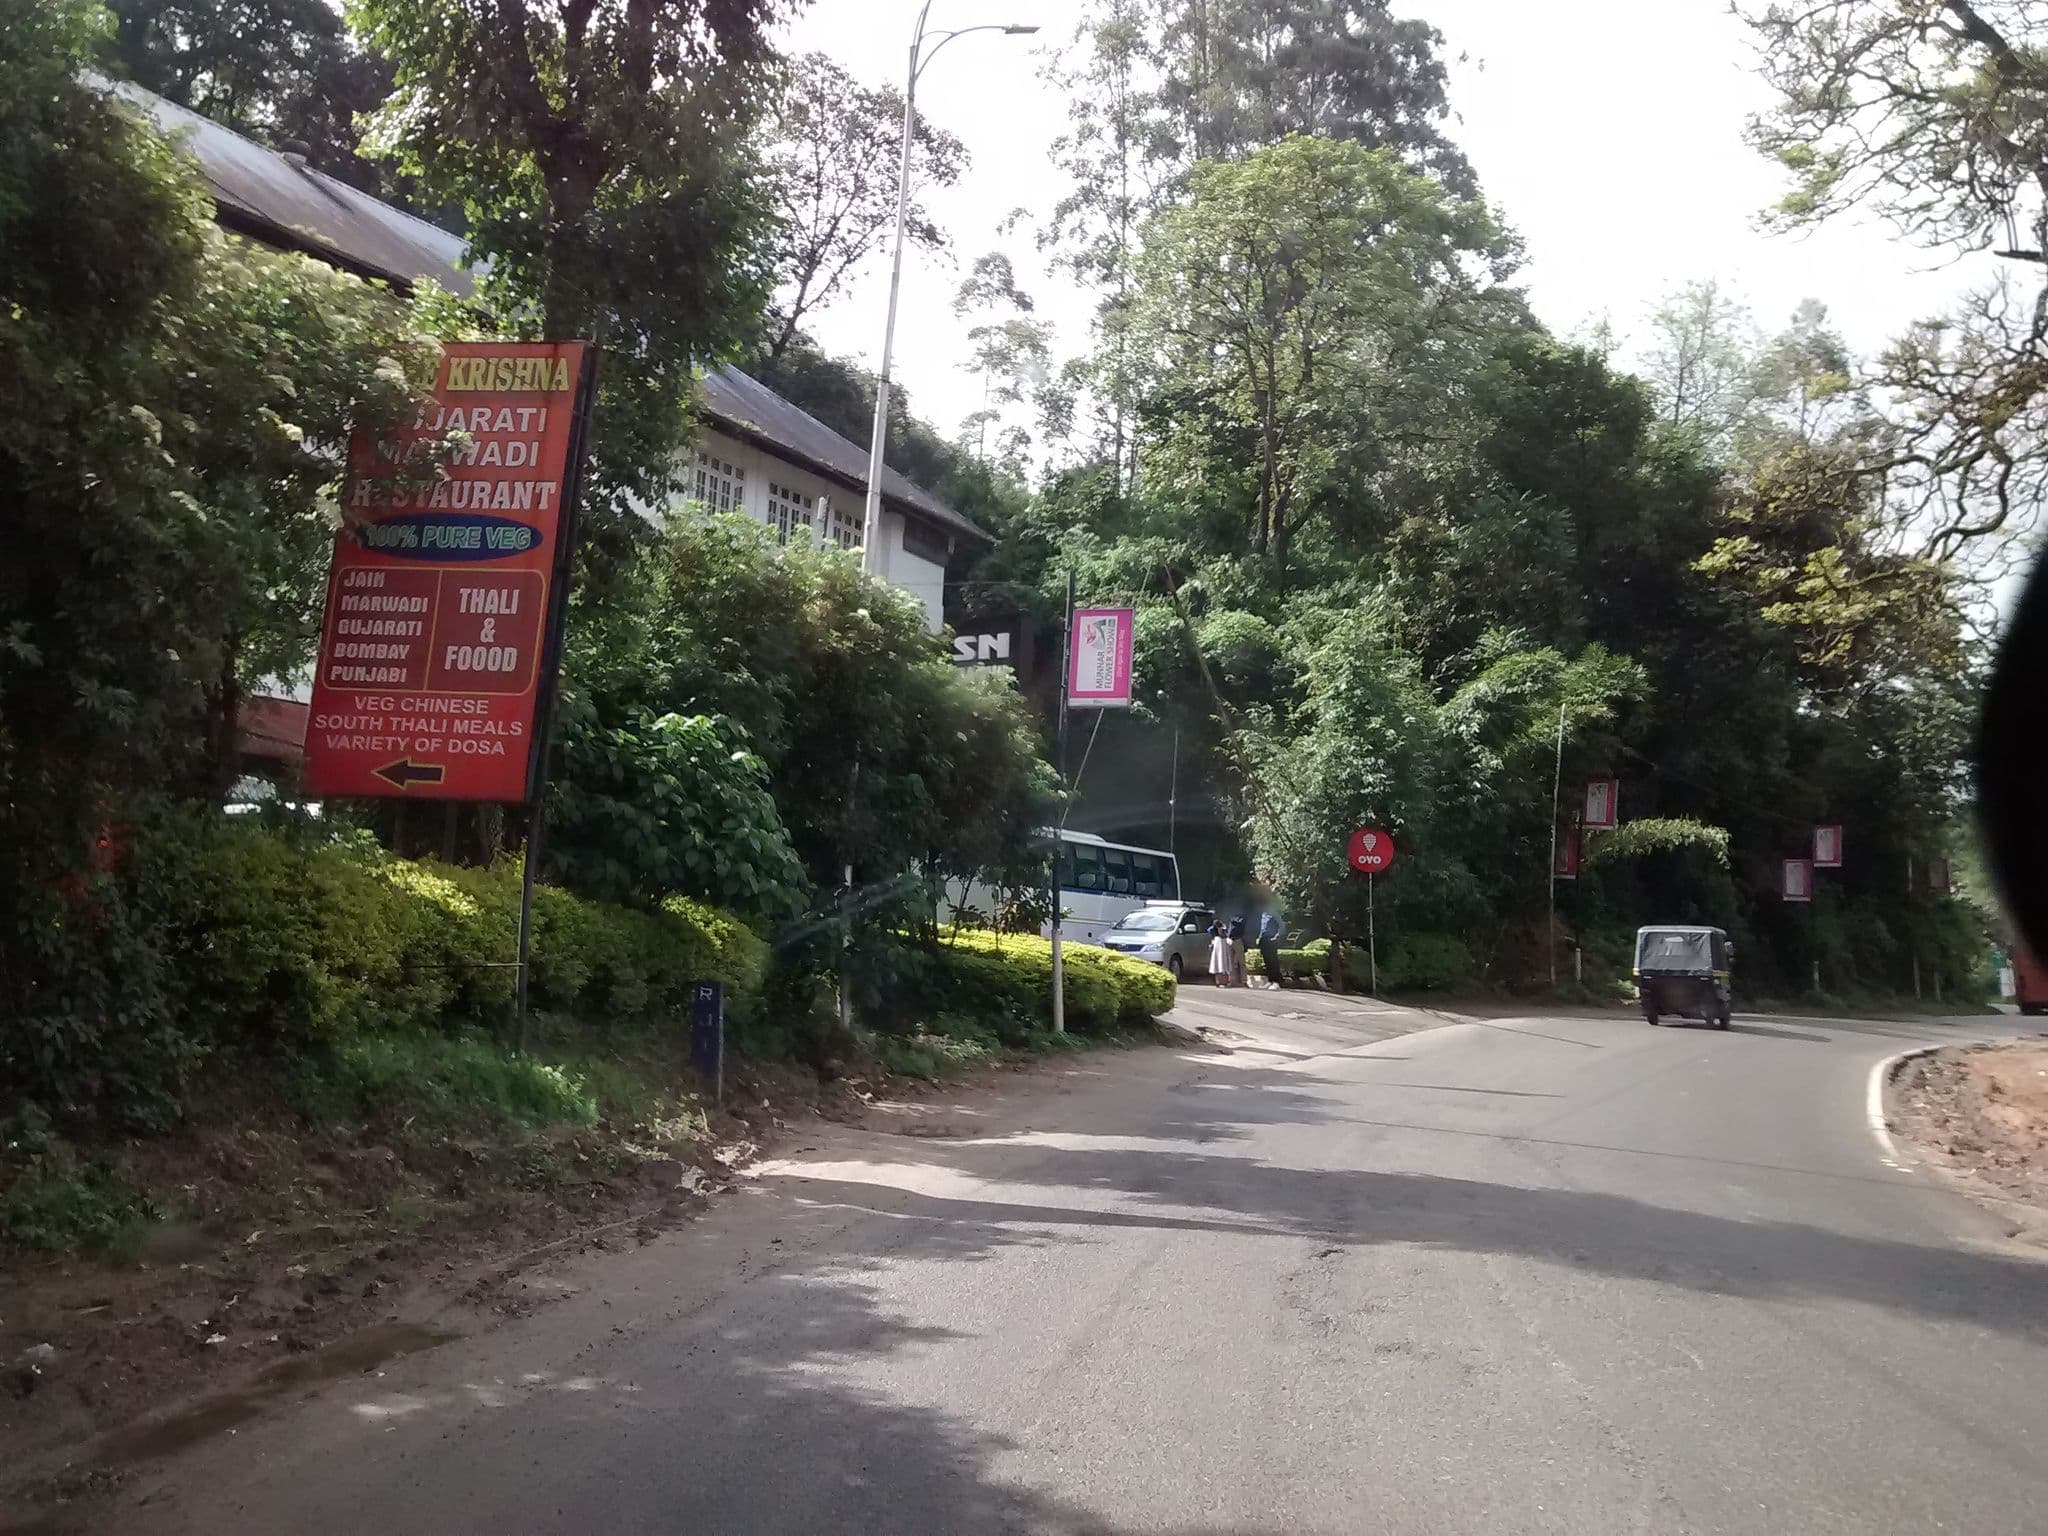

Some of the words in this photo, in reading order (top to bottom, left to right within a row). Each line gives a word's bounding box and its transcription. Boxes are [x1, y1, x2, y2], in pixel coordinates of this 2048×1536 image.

[447, 357, 569, 392] KRISHNA
[413, 407, 547, 432] JARATI
[367, 525, 418, 548] 100%
[422, 525, 481, 549] PURE
[485, 527, 531, 550] VEG
[343, 571, 385, 588] JAIN
[341, 595, 428, 613] MARWADI
[459, 588, 520, 614] THALI
[338, 619, 423, 637] GUJARATI
[479, 618, 496, 642] &
[334, 642, 410, 660] BOMBAY
[444, 646, 518, 671] FOOOD
[331, 665, 407, 683] PUNJABI
[1104, 656, 1113, 689] FLOWER
[355, 695, 395, 712] VEG
[401, 698, 489, 715] CHINESE
[315, 713, 382, 730] SOUTH
[390, 716, 447, 734] THALI
[453, 719, 523, 737] MEALS
[326, 734, 409, 752] VARIETY
[413, 737, 443, 754] OF
[448, 738, 505, 756] DOSA
[1358, 855, 1382, 864] OYO
